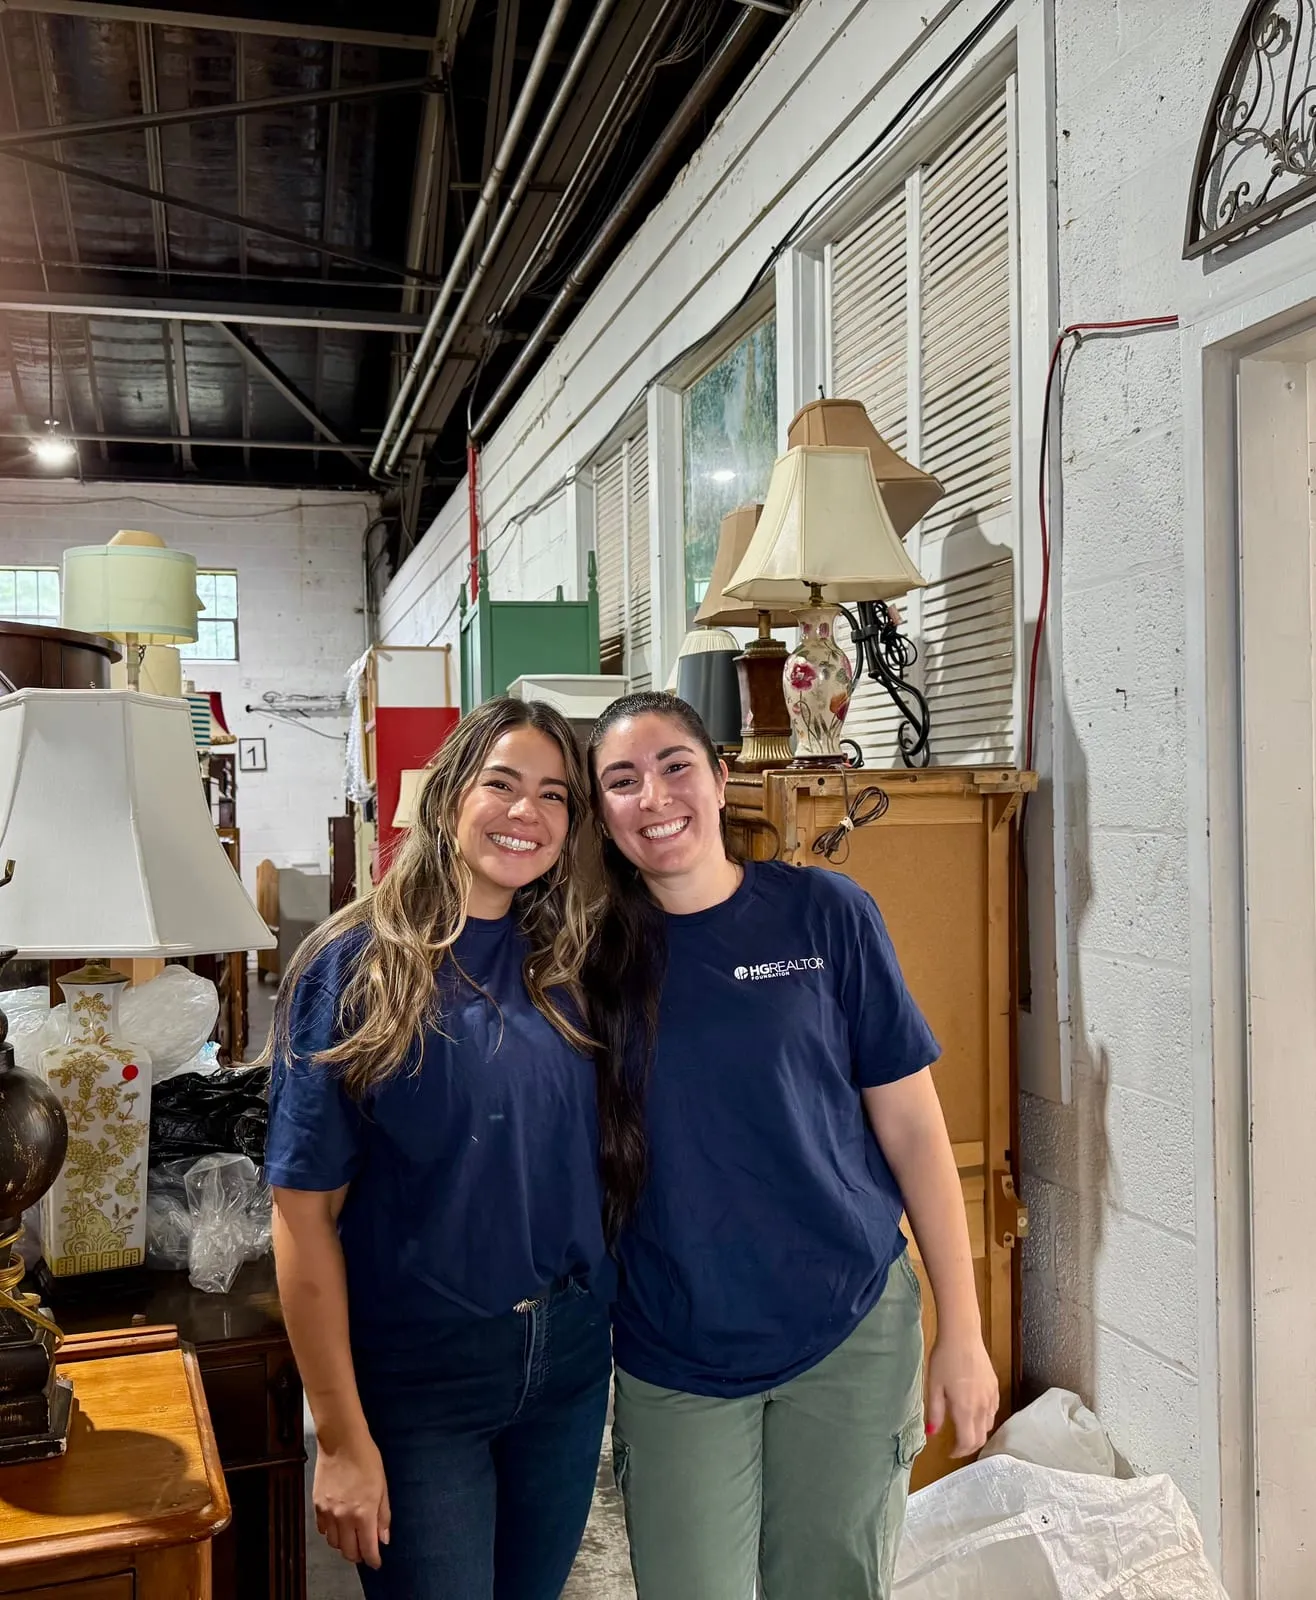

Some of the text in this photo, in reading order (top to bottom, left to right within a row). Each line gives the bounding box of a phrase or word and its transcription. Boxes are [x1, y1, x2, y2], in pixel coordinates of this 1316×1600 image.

[246, 746, 256, 767] 1
[749, 957, 824, 977] HGREALTOR
[751, 971, 790, 981] FOUNDATION
